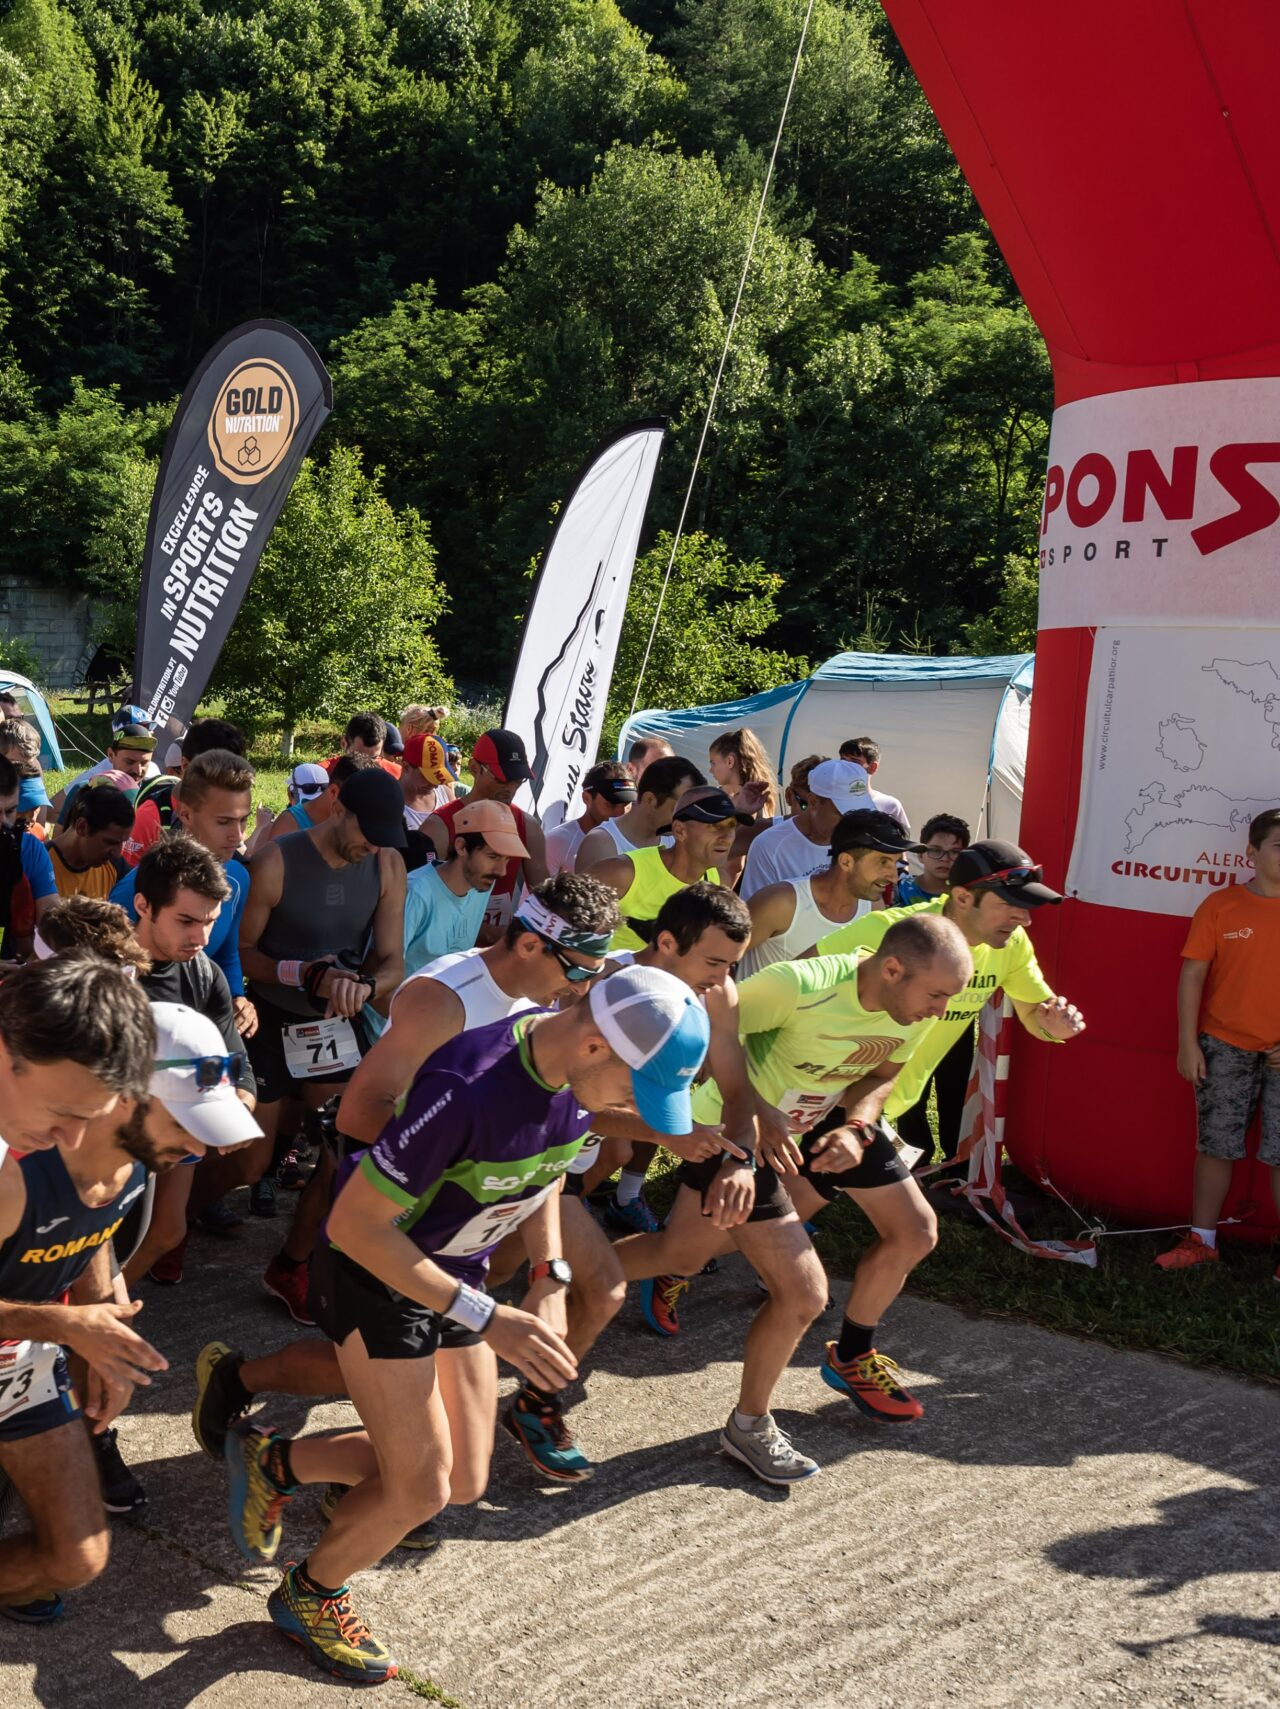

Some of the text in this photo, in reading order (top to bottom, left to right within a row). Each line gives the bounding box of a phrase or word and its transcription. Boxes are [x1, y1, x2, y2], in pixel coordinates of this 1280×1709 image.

[226, 385, 283, 416] GOLD
[225, 414, 281, 434] NUTRITION
[160, 464, 210, 556] EXCELLENCE
[159, 490, 225, 622] IN SPORTS
[1048, 538, 1169, 567] SPORT
[168, 498, 260, 662] NUTRITION
[1111, 860, 1237, 887] CIRCUITUL
[306, 1039, 339, 1064] 71
